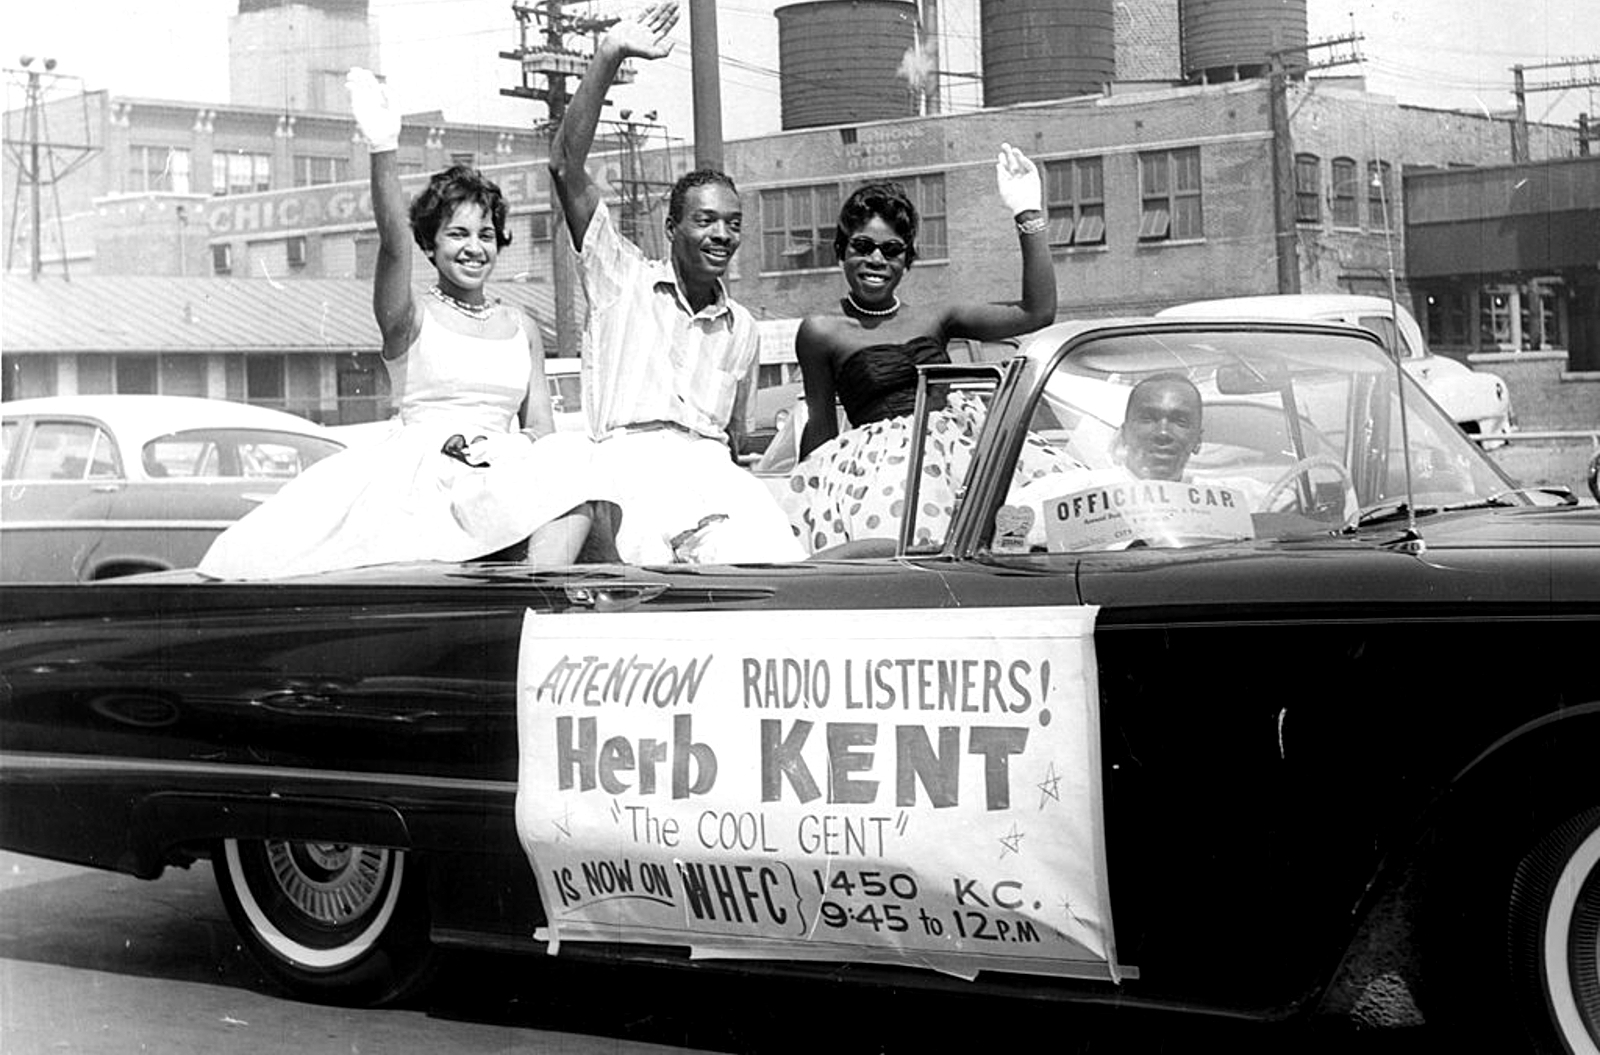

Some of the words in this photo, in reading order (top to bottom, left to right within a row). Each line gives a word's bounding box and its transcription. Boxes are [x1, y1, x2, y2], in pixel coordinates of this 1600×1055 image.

[1056, 485, 1170, 521] OFFICIAL
[1188, 487, 1235, 508] CAR
[536, 654, 713, 709] ATTENTION
[742, 657, 831, 709] RADIO
[845, 658, 1052, 728] LISTENERS!
[556, 713, 718, 800] Herb
[760, 718, 1030, 812] KENT
[697, 810, 779, 853] COOL
[552, 866, 581, 907] IS
[581, 858, 635, 897] NOW
[639, 862, 673, 899] ON
[675, 862, 788, 925] WHFC
[813, 868, 918, 900] 1450
[820, 900, 909, 933] 9:45
[919, 907, 944, 936] to
